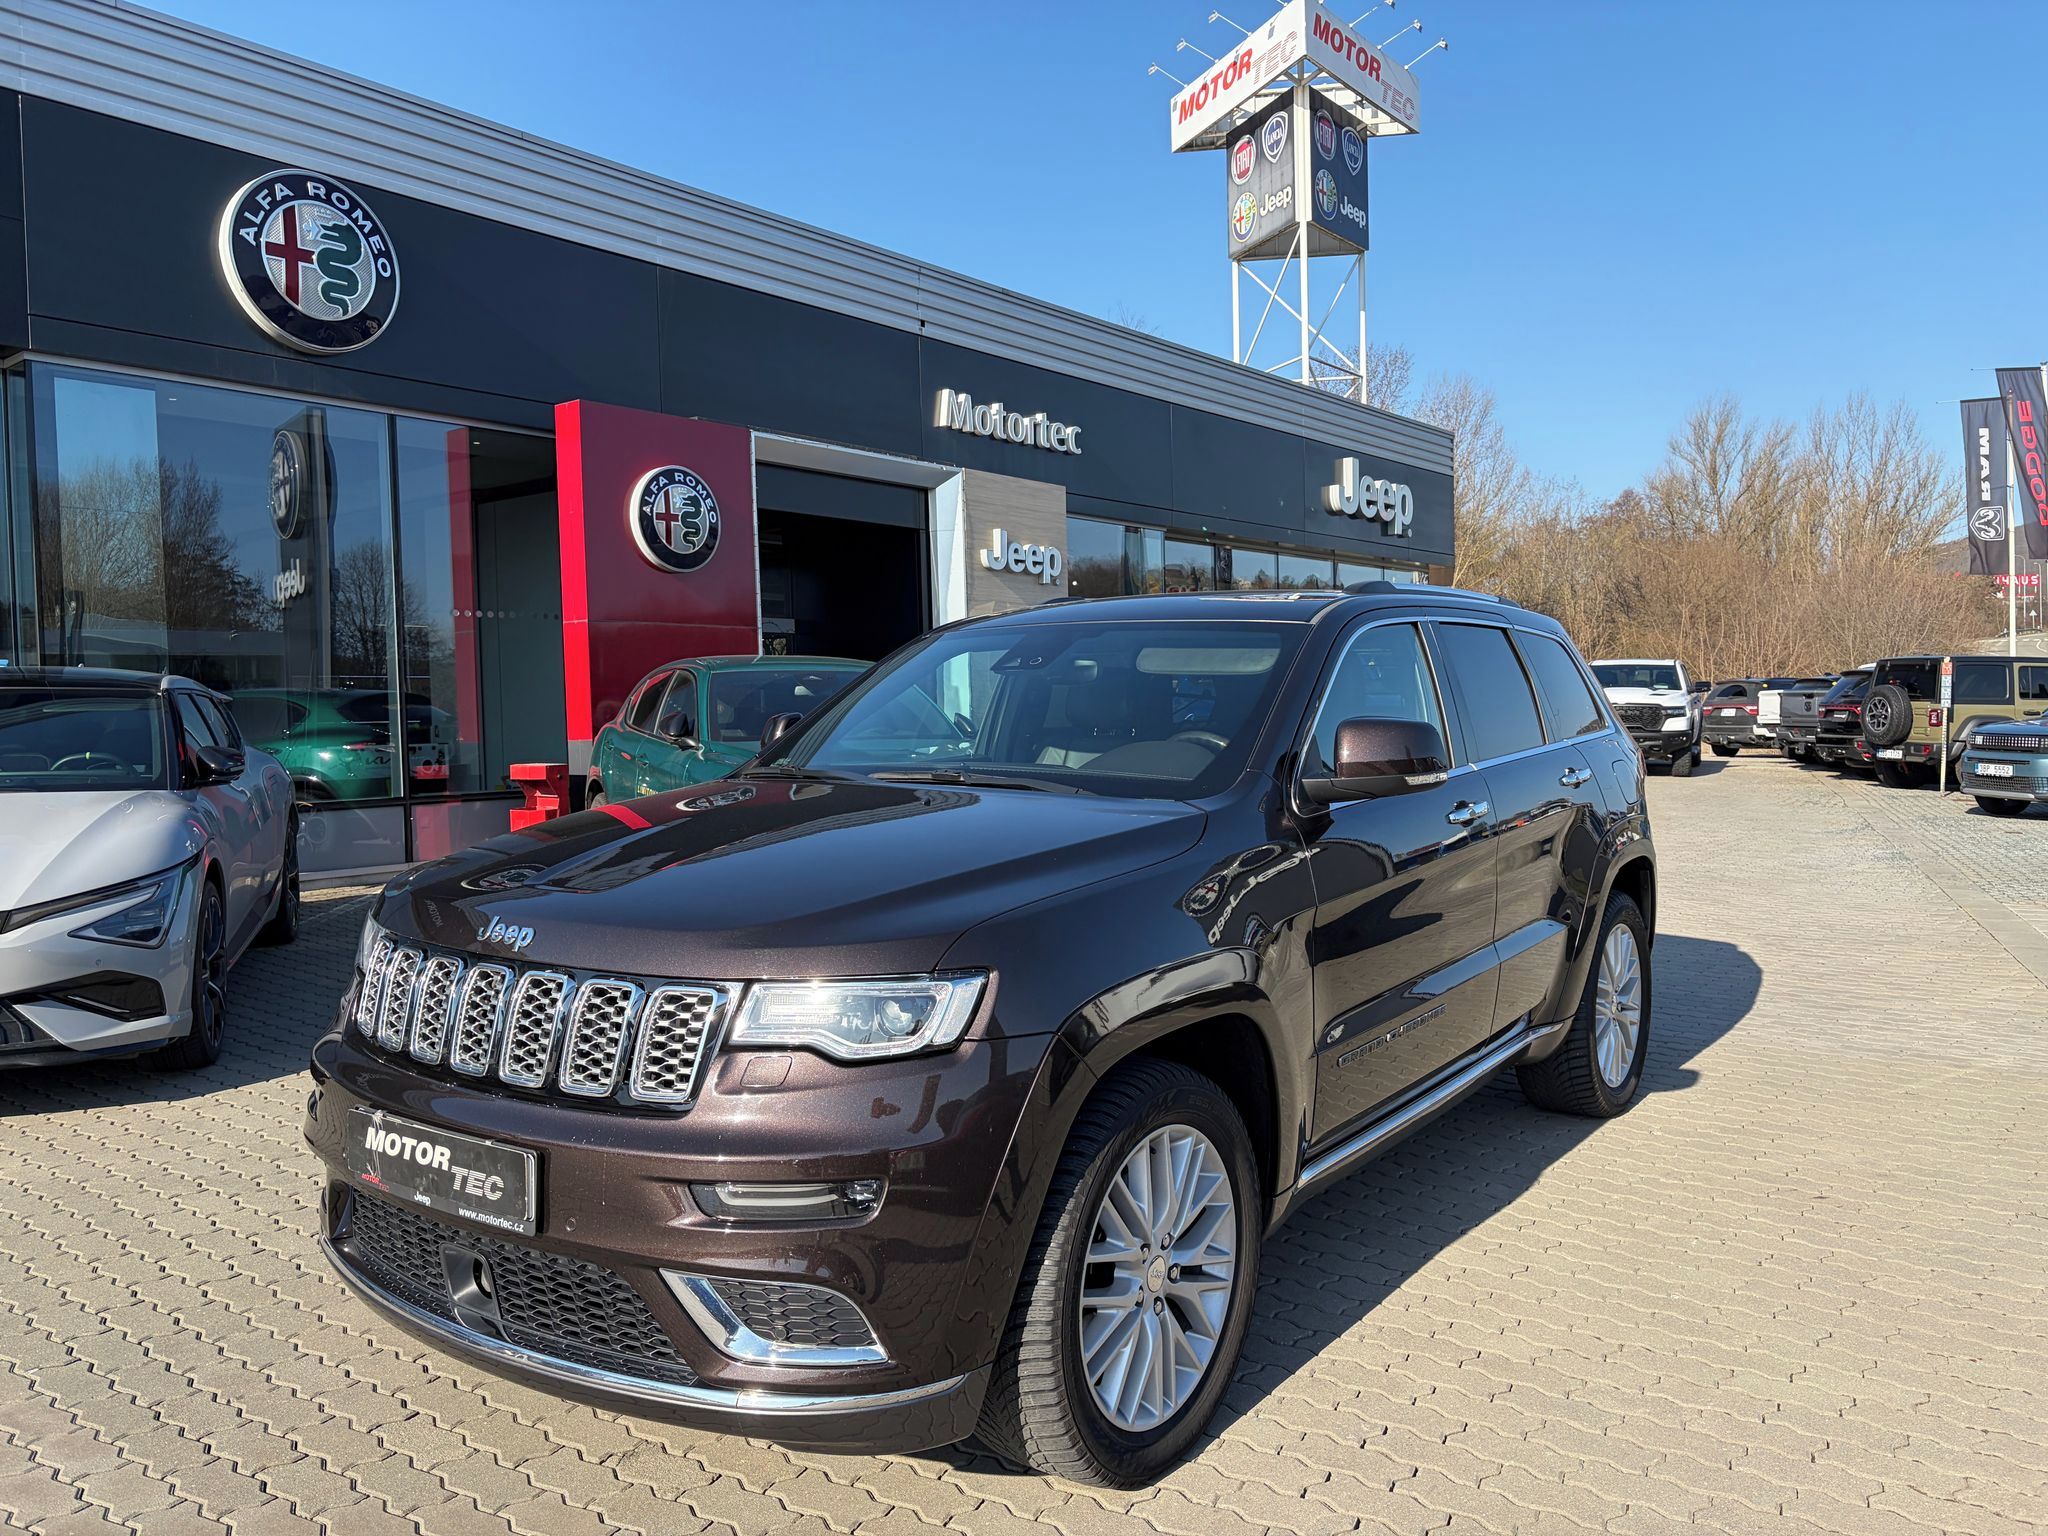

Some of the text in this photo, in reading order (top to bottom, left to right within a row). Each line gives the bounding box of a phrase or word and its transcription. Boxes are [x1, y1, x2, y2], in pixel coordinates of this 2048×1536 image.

[1178, 30, 1298, 125] MOTOR TEC
[1313, 12, 1415, 121] MOTOR TEC
[1236, 146, 1251, 174] FIAT
[1319, 122, 1332, 149] FIAT
[1260, 186, 1292, 217] Jeep
[1340, 195, 1366, 228] Jeep
[239, 181, 392, 278] ALFA ROMEO
[936, 388, 1082, 455] Motortec
[642, 472, 717, 523] ALFA ROMEO
[1324, 457, 1413, 537] Jeep
[980, 528, 1062, 585] Jeep
[477, 915, 536, 952] Jeep
[365, 1127, 505, 1201] MOTOR TEC
[413, 1191, 431, 1206] Jeep
[458, 1206, 525, 1232] www.motortec.cz
